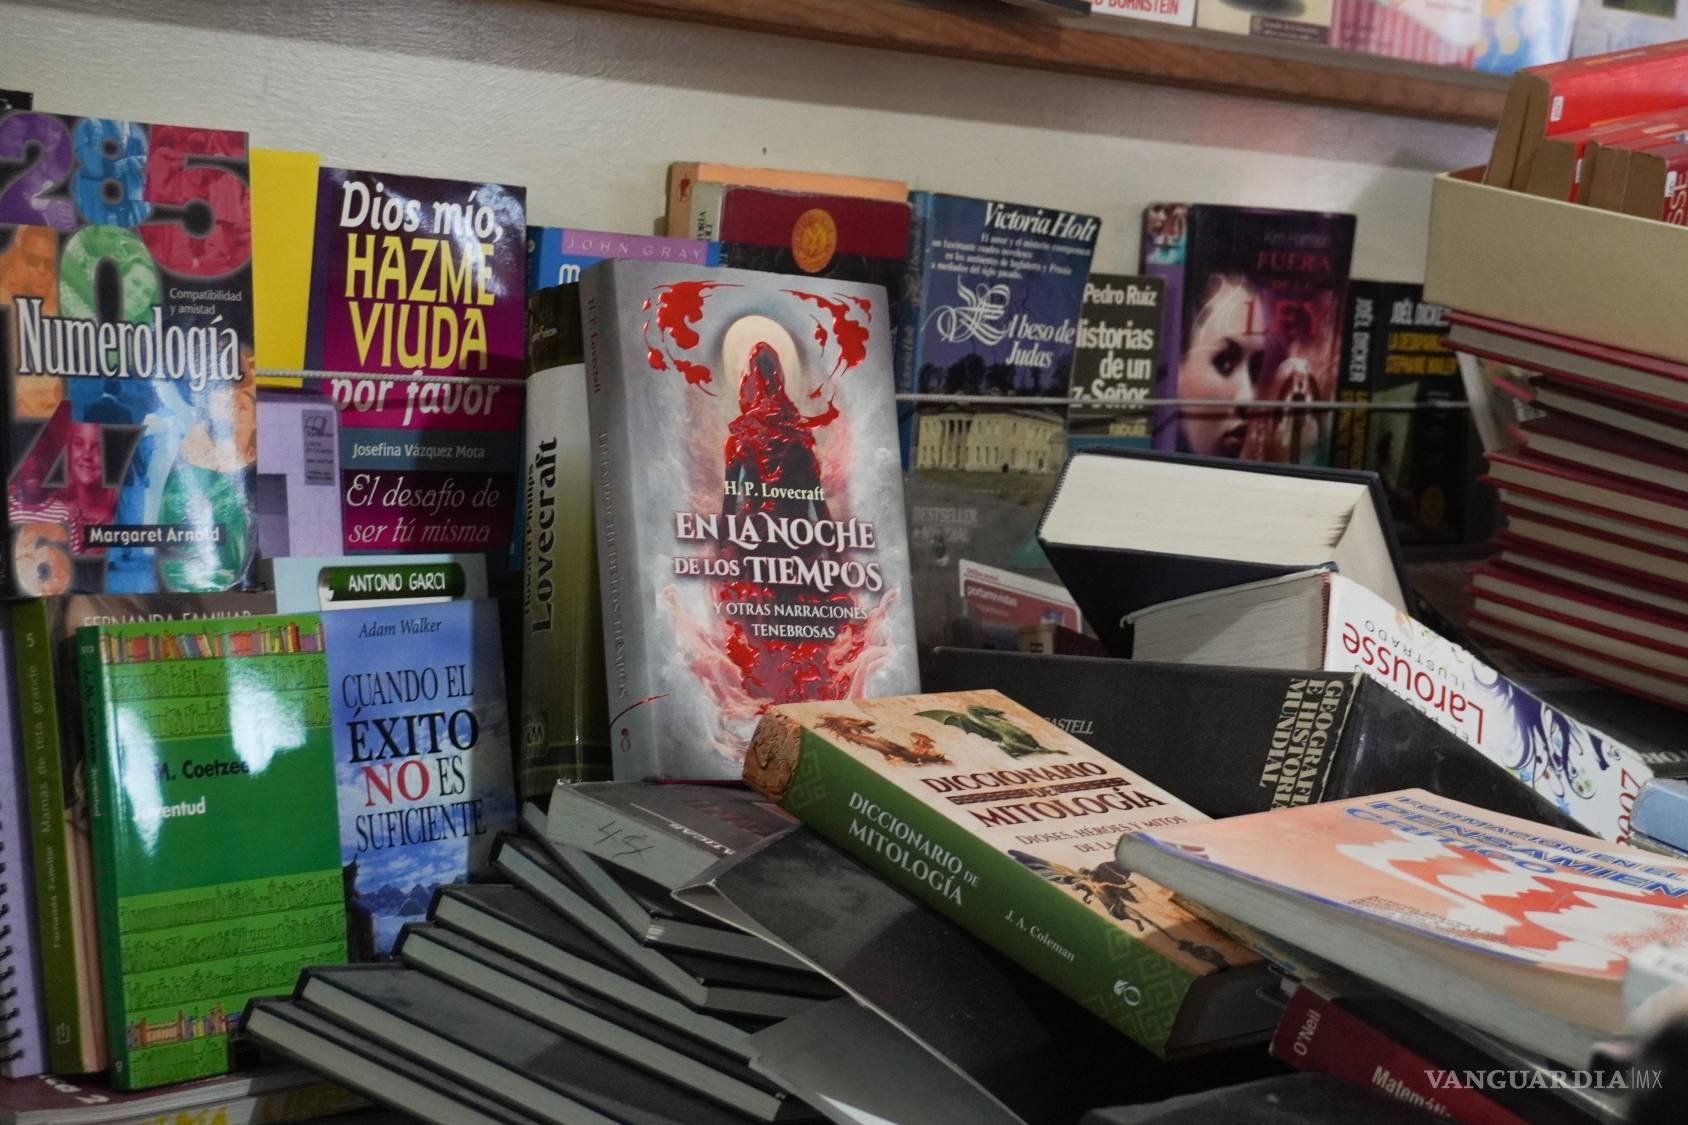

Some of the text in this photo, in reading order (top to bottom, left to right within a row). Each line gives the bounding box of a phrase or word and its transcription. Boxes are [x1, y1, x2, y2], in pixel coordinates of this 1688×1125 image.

[340, 181, 503, 241] Dios mío,
[983, 202, 1098, 242] Victoria Holt
[567, 239, 629, 255] JOHN
[643, 247, 703, 260] GRAY
[346, 233, 496, 306] HAZME
[169, 288, 243, 302] Compatibilidad
[169, 304, 216, 317] y amistad
[1084, 283, 1158, 306] Pedro Ruiz
[15, 298, 243, 392] Numerología
[349, 302, 488, 370] VIUDA
[1018, 315, 1054, 341] beso
[1054, 318, 1077, 345] de
[1005, 341, 1053, 368] Judas
[1100, 350, 1152, 380] de un
[332, 373, 500, 427] por favor
[353, 440, 485, 460] Josefina Vázquez Mota
[346, 474, 500, 511] El desafío de
[724, 481, 826, 501] H. P. Lovecraft
[89, 525, 220, 544] Margaret Arnold
[349, 512, 489, 544] ser tú misma
[532, 437, 558, 633] Lovecraft
[676, 512, 719, 540] EN
[726, 514, 762, 550] LA
[758, 512, 876, 553] NOCHE
[348, 571, 447, 592] ANTONIO GARCI
[674, 556, 882, 592] DE LOS TIEMPOS
[358, 619, 442, 639] Adam Walker
[714, 603, 868, 620] Y OTRAS NARRACIONES
[752, 624, 836, 639] TENEBROSAS
[342, 664, 475, 708] CUANDO EL
[1342, 621, 1484, 745] Larousse
[347, 706, 479, 764] ÉXITO
[1258, 678, 1309, 788] MUNDIAL
[182, 759, 251, 779] Coetzee
[363, 754, 467, 807] NO ES
[920, 761, 1108, 794] DICCIONARIO
[967, 786, 1168, 828] MITOLOGÍA
[1142, 815, 1188, 828] MITOS
[355, 798, 488, 853] SUFICIENTE
[848, 791, 980, 888] DICCIONARIO DE
[848, 819, 964, 907] MITOLOGÍA
[1073, 843, 1098, 853] DE
[1015, 916, 1029, 932] A.
[1029, 926, 1076, 963] Coleman
[1293, 1009, 1322, 1057] O'Neil
